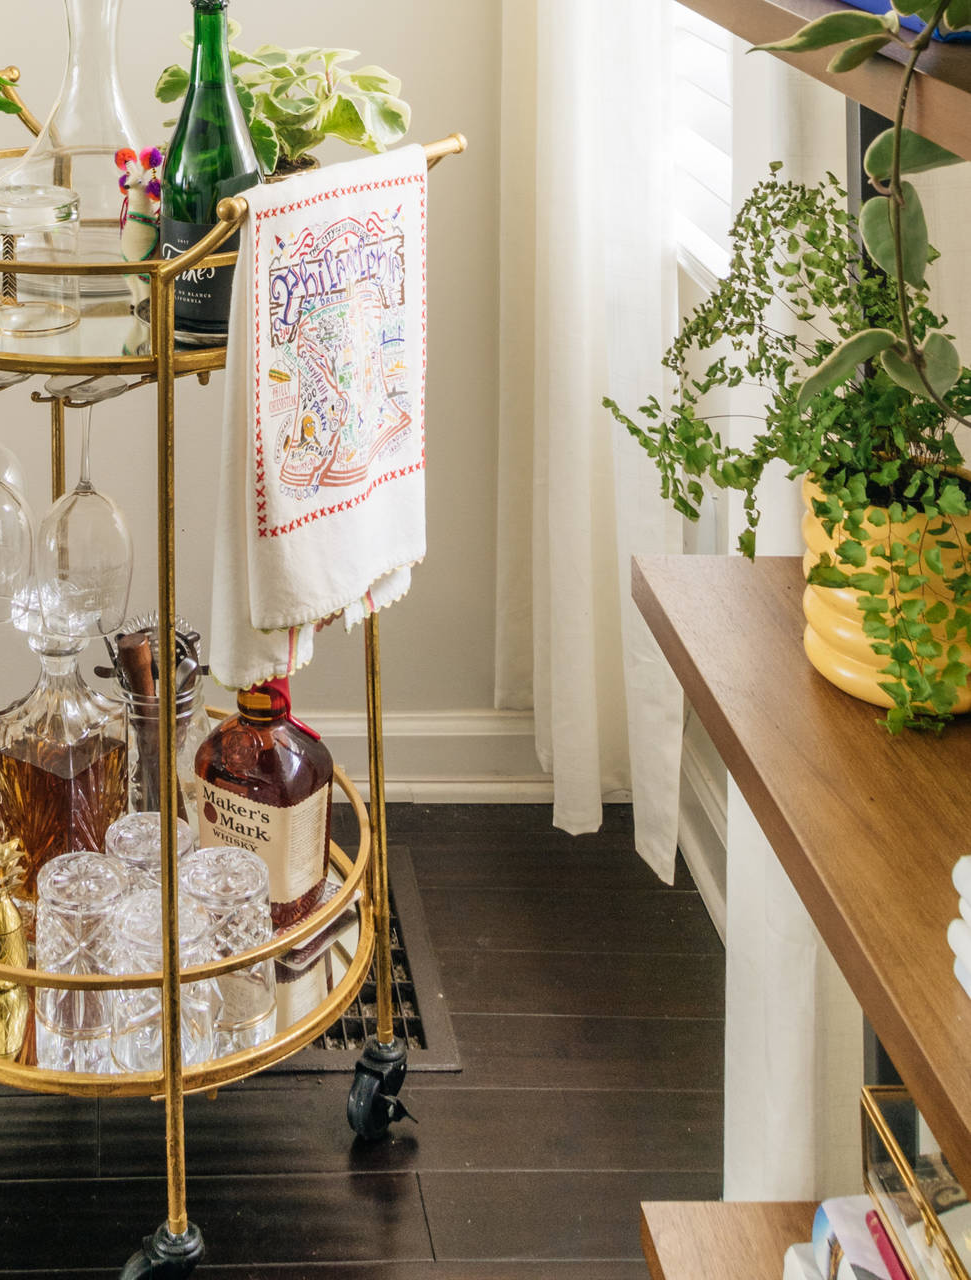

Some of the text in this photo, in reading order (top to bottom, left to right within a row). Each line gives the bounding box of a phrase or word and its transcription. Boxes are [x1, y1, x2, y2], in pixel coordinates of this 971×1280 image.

[203, 784, 270, 824] Maker's
[213, 827, 259, 853] WHISKY
[219, 811, 270, 842] Mark
